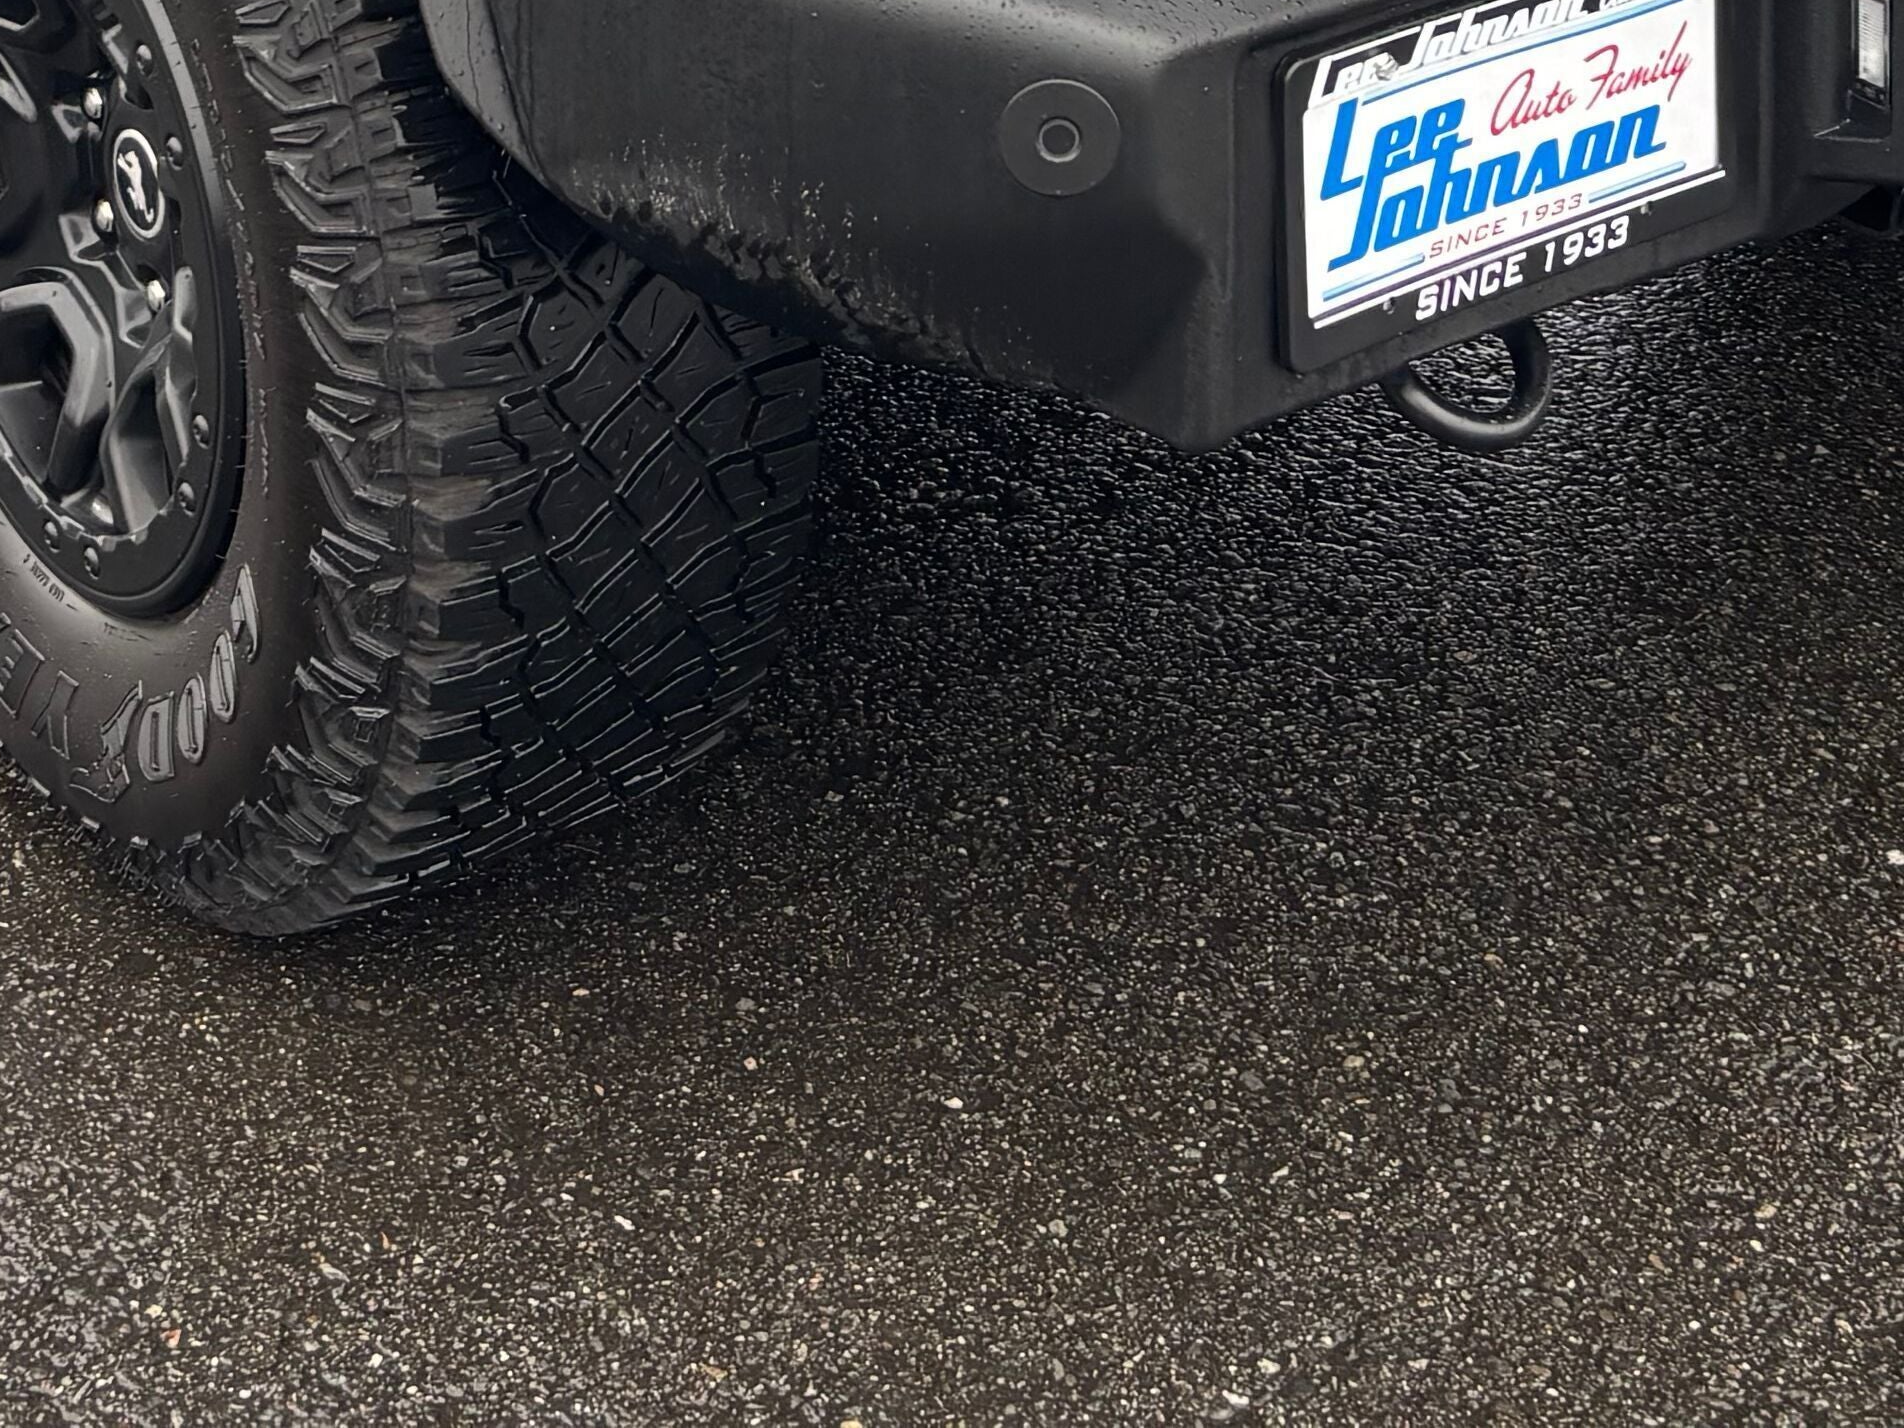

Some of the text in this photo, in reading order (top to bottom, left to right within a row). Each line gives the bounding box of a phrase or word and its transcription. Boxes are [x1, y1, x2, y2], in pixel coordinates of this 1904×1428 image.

[1490, 20, 1694, 137] Auto Family
[1320, 97, 1473, 201] Lee
[1327, 104, 1667, 273] Johnson
[1415, 215, 1632, 321] SINCE 1933
[1428, 192, 1585, 260] SINCE 1933
